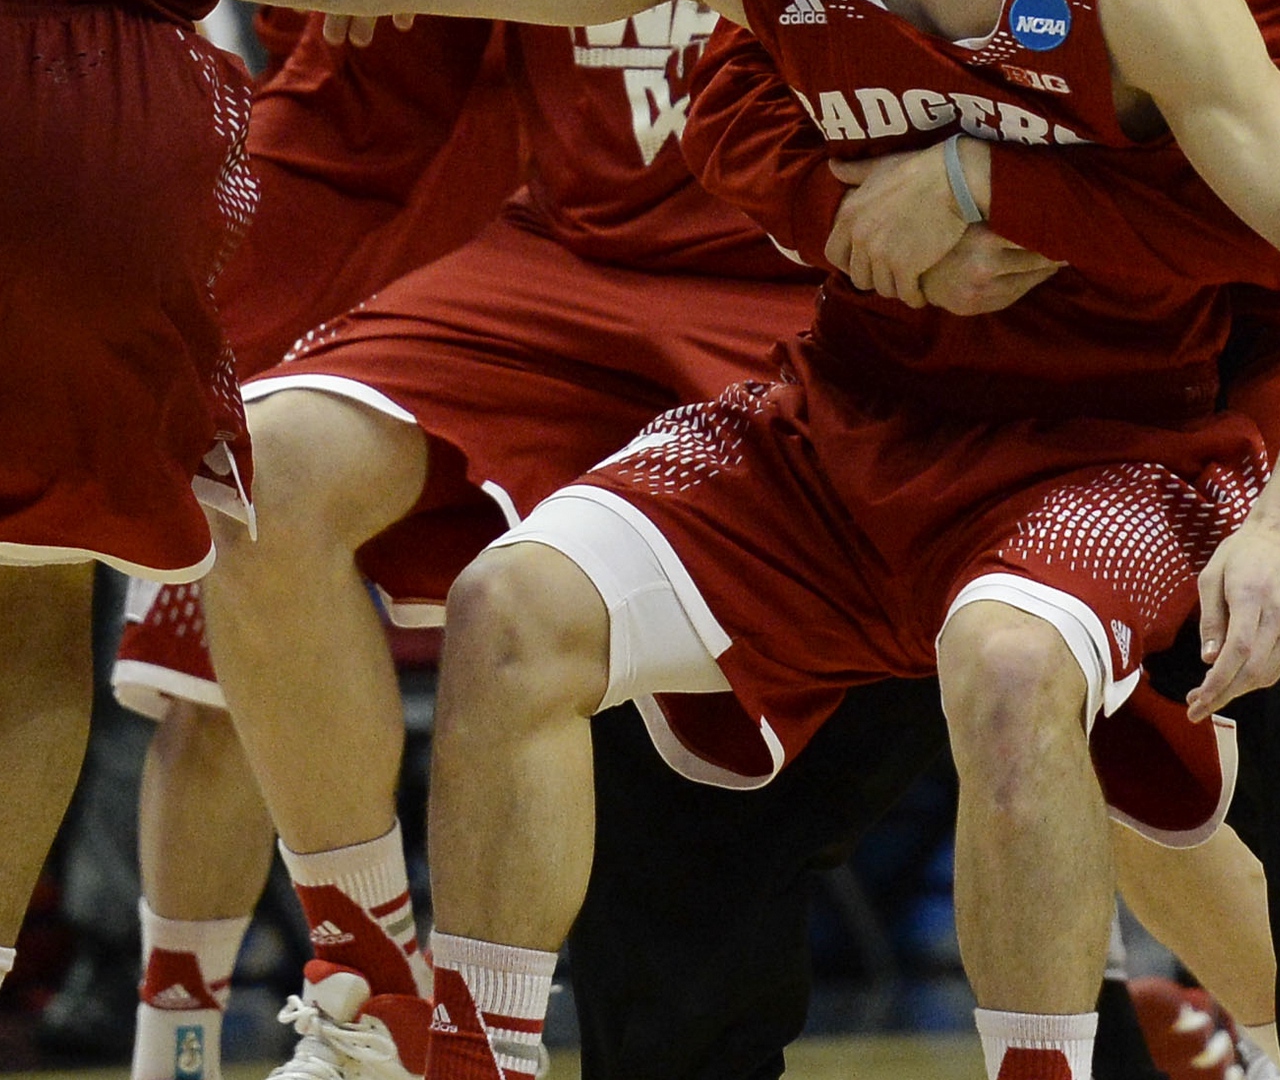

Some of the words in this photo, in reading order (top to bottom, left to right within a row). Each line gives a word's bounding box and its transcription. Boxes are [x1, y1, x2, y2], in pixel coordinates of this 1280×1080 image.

[779, 9, 828, 25] adida
[1016, 15, 1066, 36] NCAA
[789, 87, 1096, 146] ADGER
